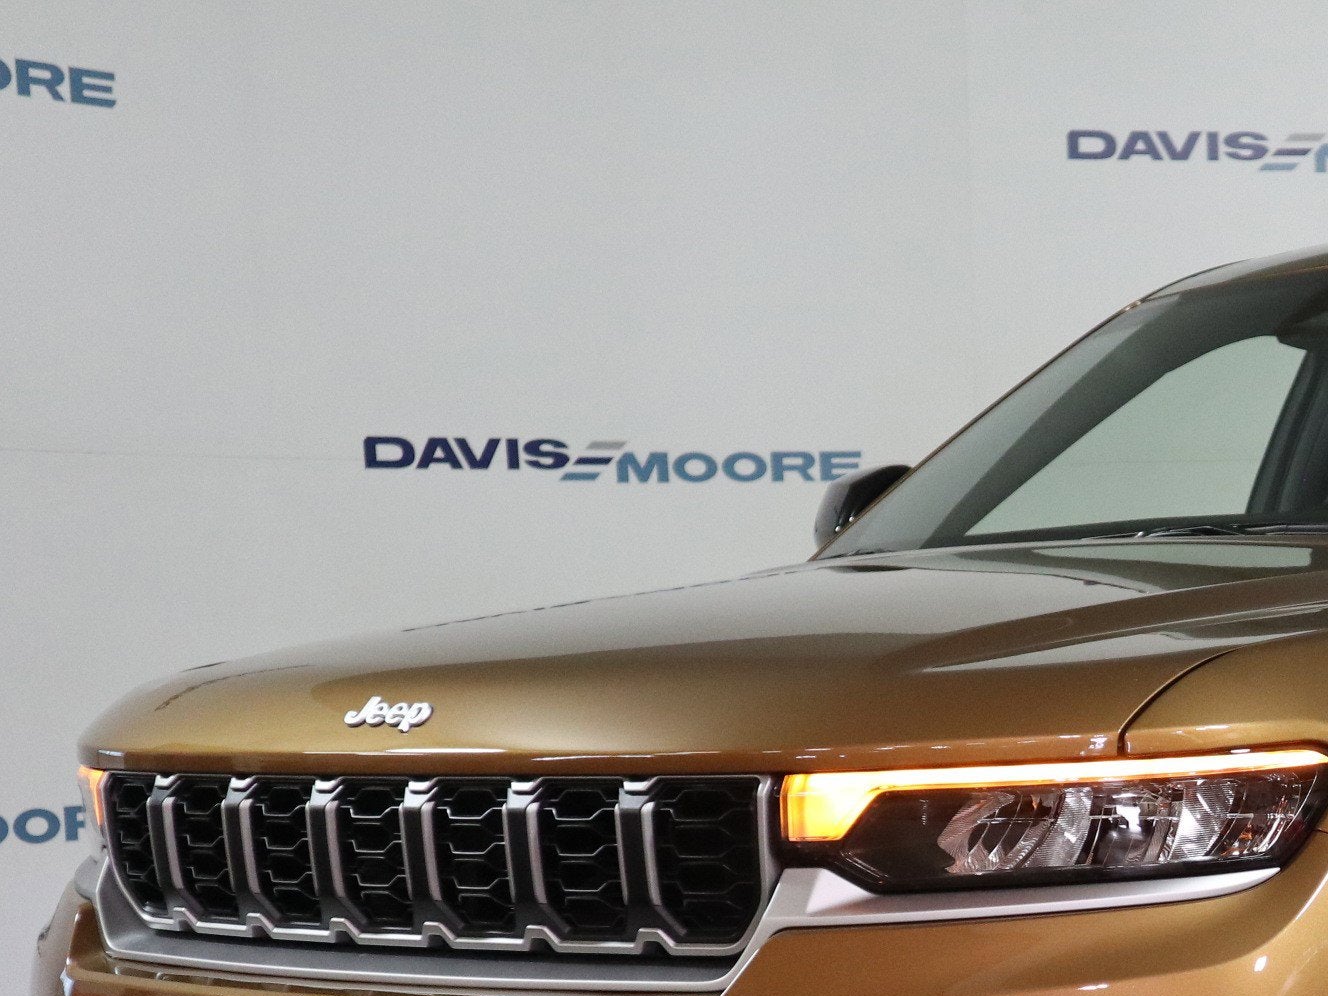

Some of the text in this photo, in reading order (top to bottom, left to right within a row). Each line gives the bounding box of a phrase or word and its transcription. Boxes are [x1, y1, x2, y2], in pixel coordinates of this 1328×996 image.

[0, 59, 116, 108] RE
[1066, 130, 1268, 161] DAVIS
[363, 436, 862, 484] DAVIS MOORE
[343, 696, 433, 733] Jeep
